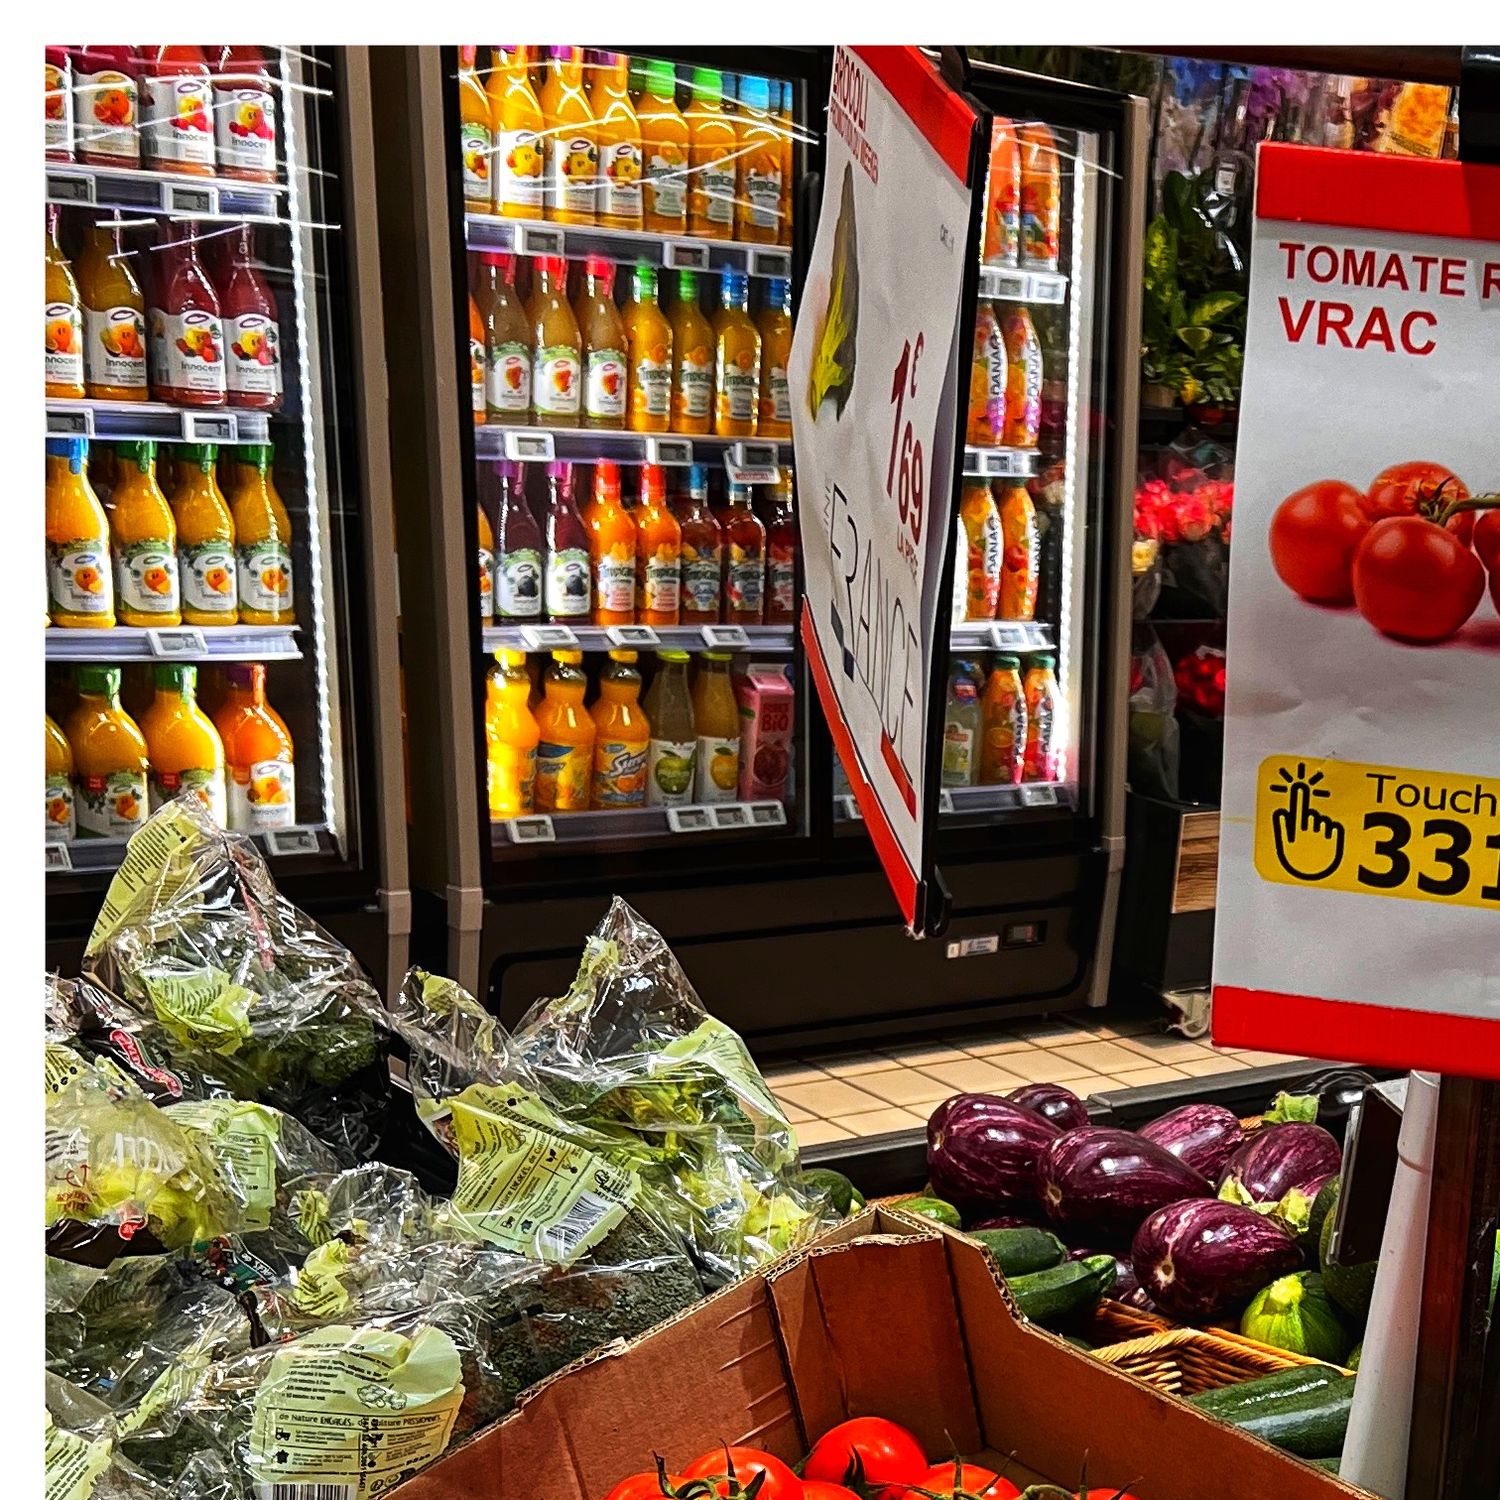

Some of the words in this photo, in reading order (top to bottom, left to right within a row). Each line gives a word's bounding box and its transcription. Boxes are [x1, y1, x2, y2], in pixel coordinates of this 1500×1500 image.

[1278, 241, 1467, 297] TOMATE
[1277, 296, 1440, 356] VRAC
[887, 338, 911, 499] 1
[898, 420, 923, 546] 69
[830, 482, 918, 784] FRANCE
[292, 1413, 318, 1425] Nature
